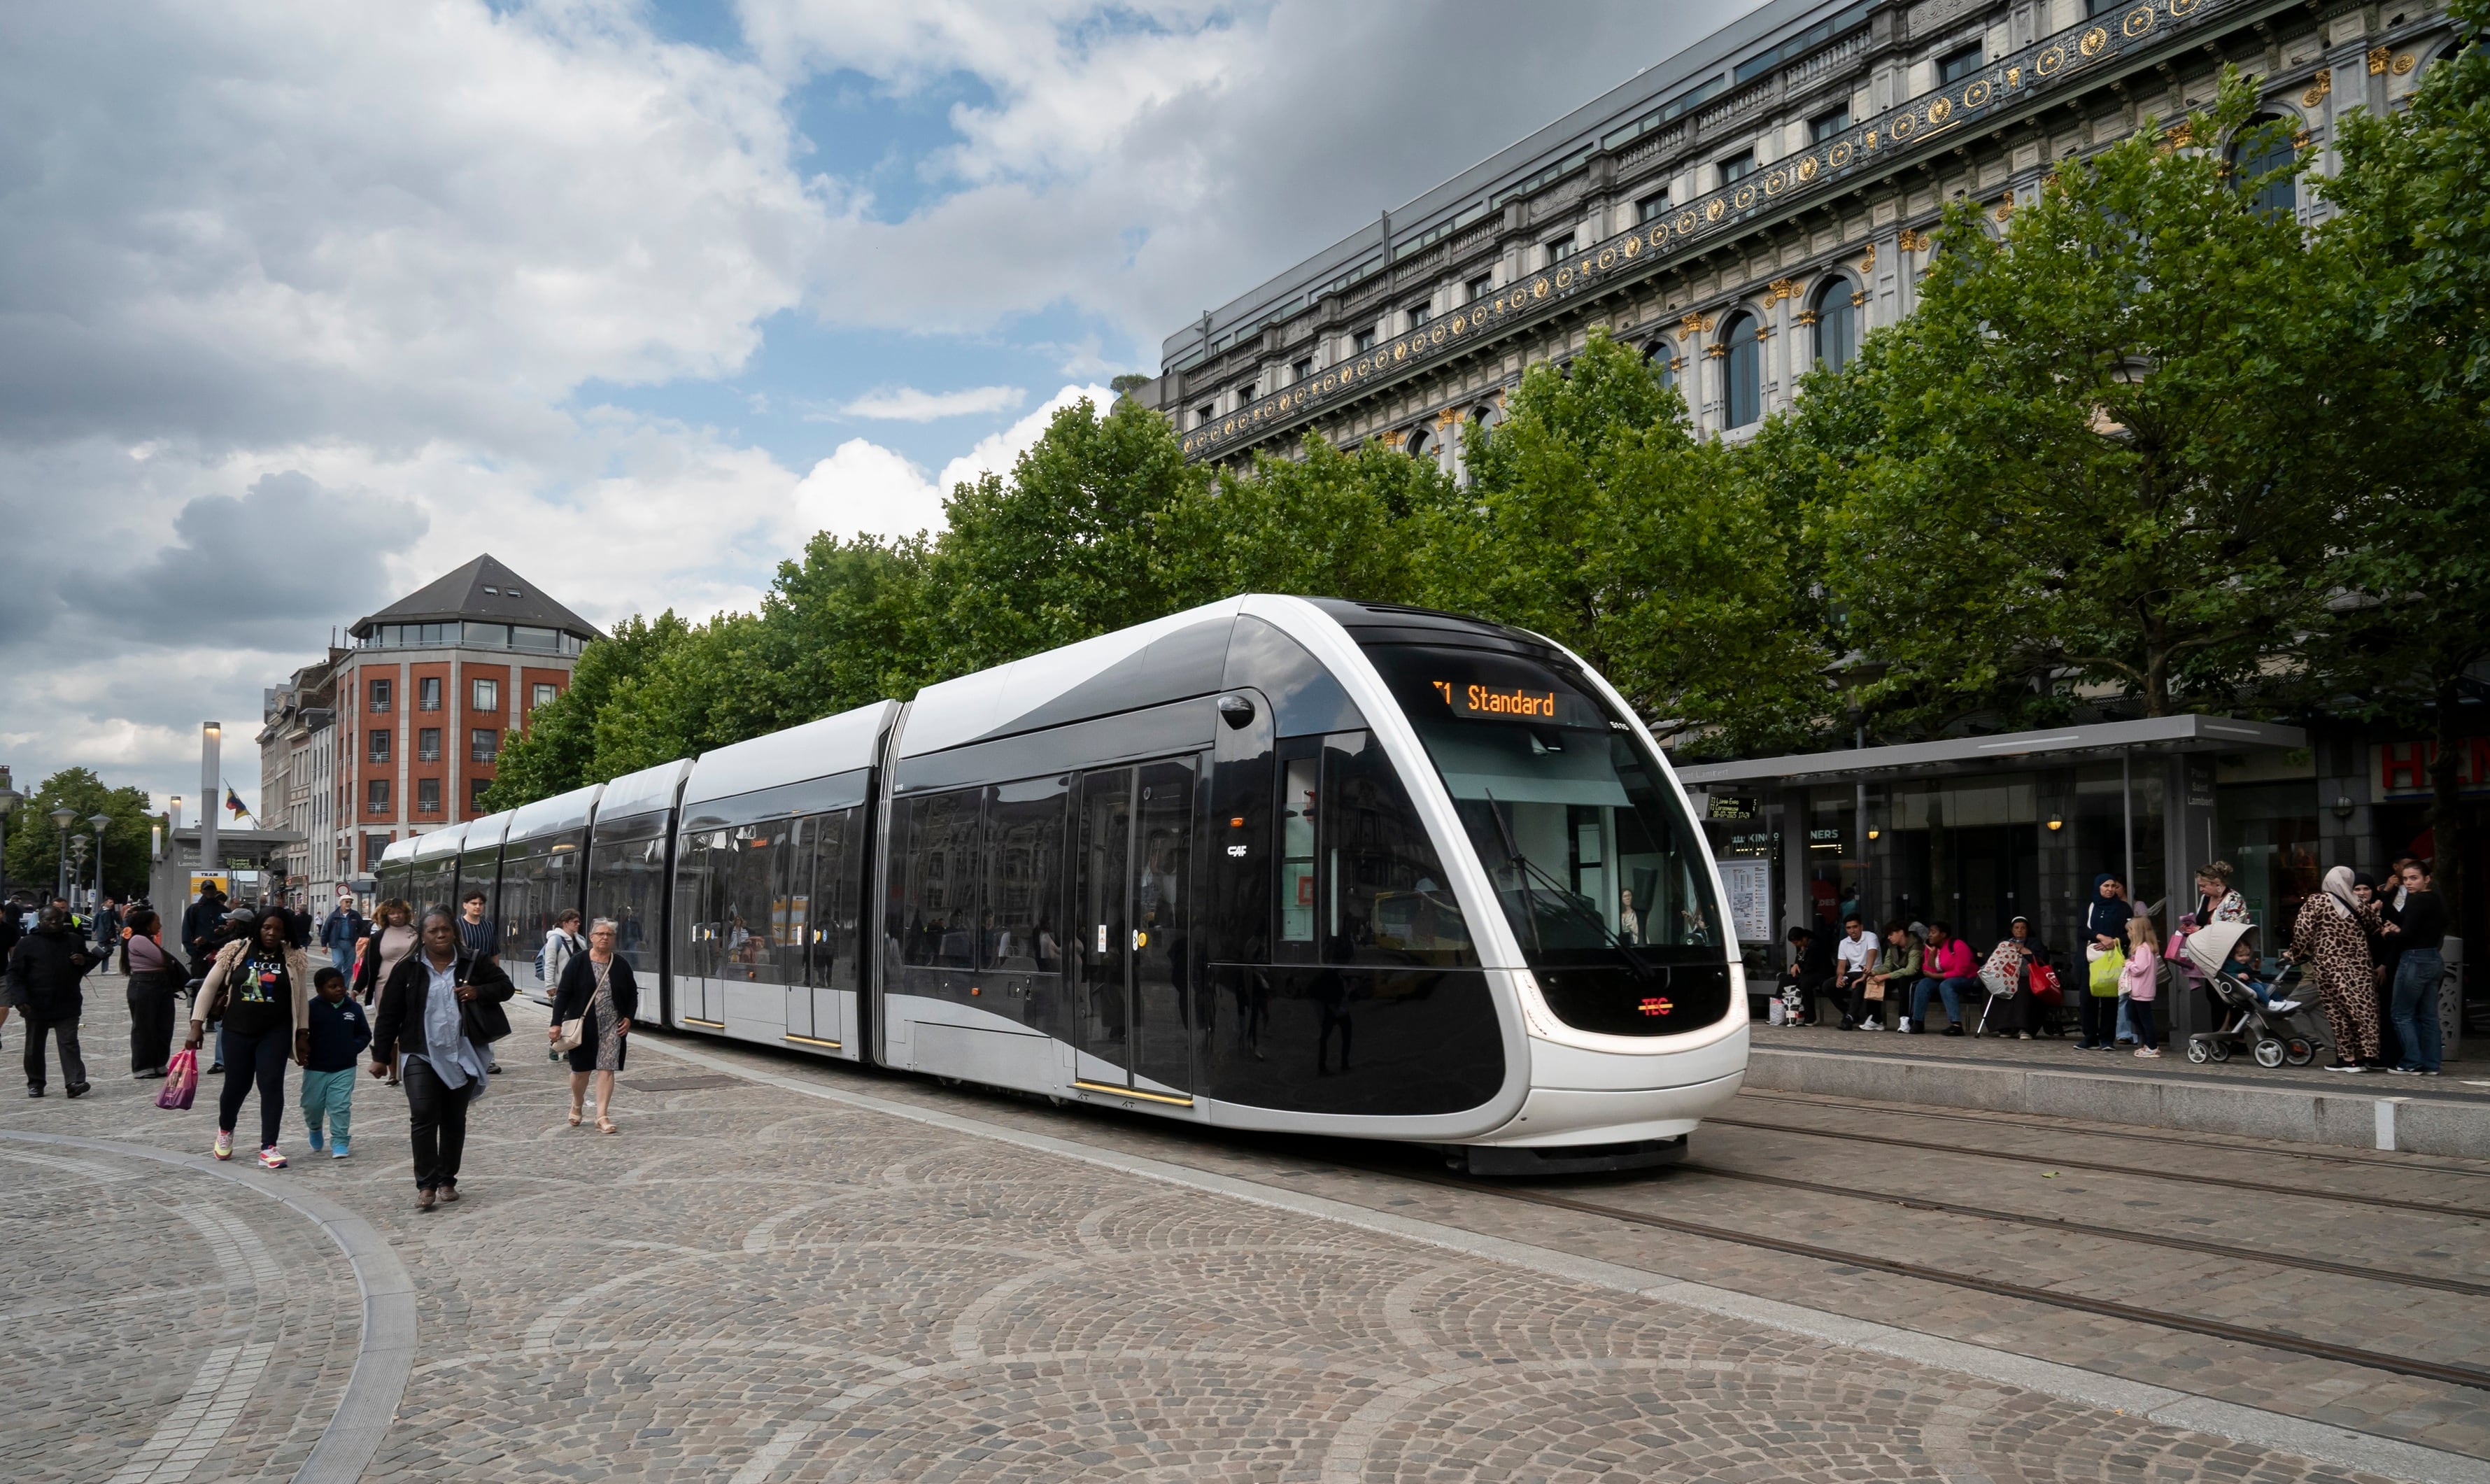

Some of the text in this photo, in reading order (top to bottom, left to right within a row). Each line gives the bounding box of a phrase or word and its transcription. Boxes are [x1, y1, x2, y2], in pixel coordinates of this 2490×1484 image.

[1469, 685, 1554, 716] Standard
[1609, 721, 1629, 730] 5115
[2188, 795, 2214, 806] Lambert
[1227, 845, 1247, 857] CAF
[1641, 997, 1670, 1015] TEC
